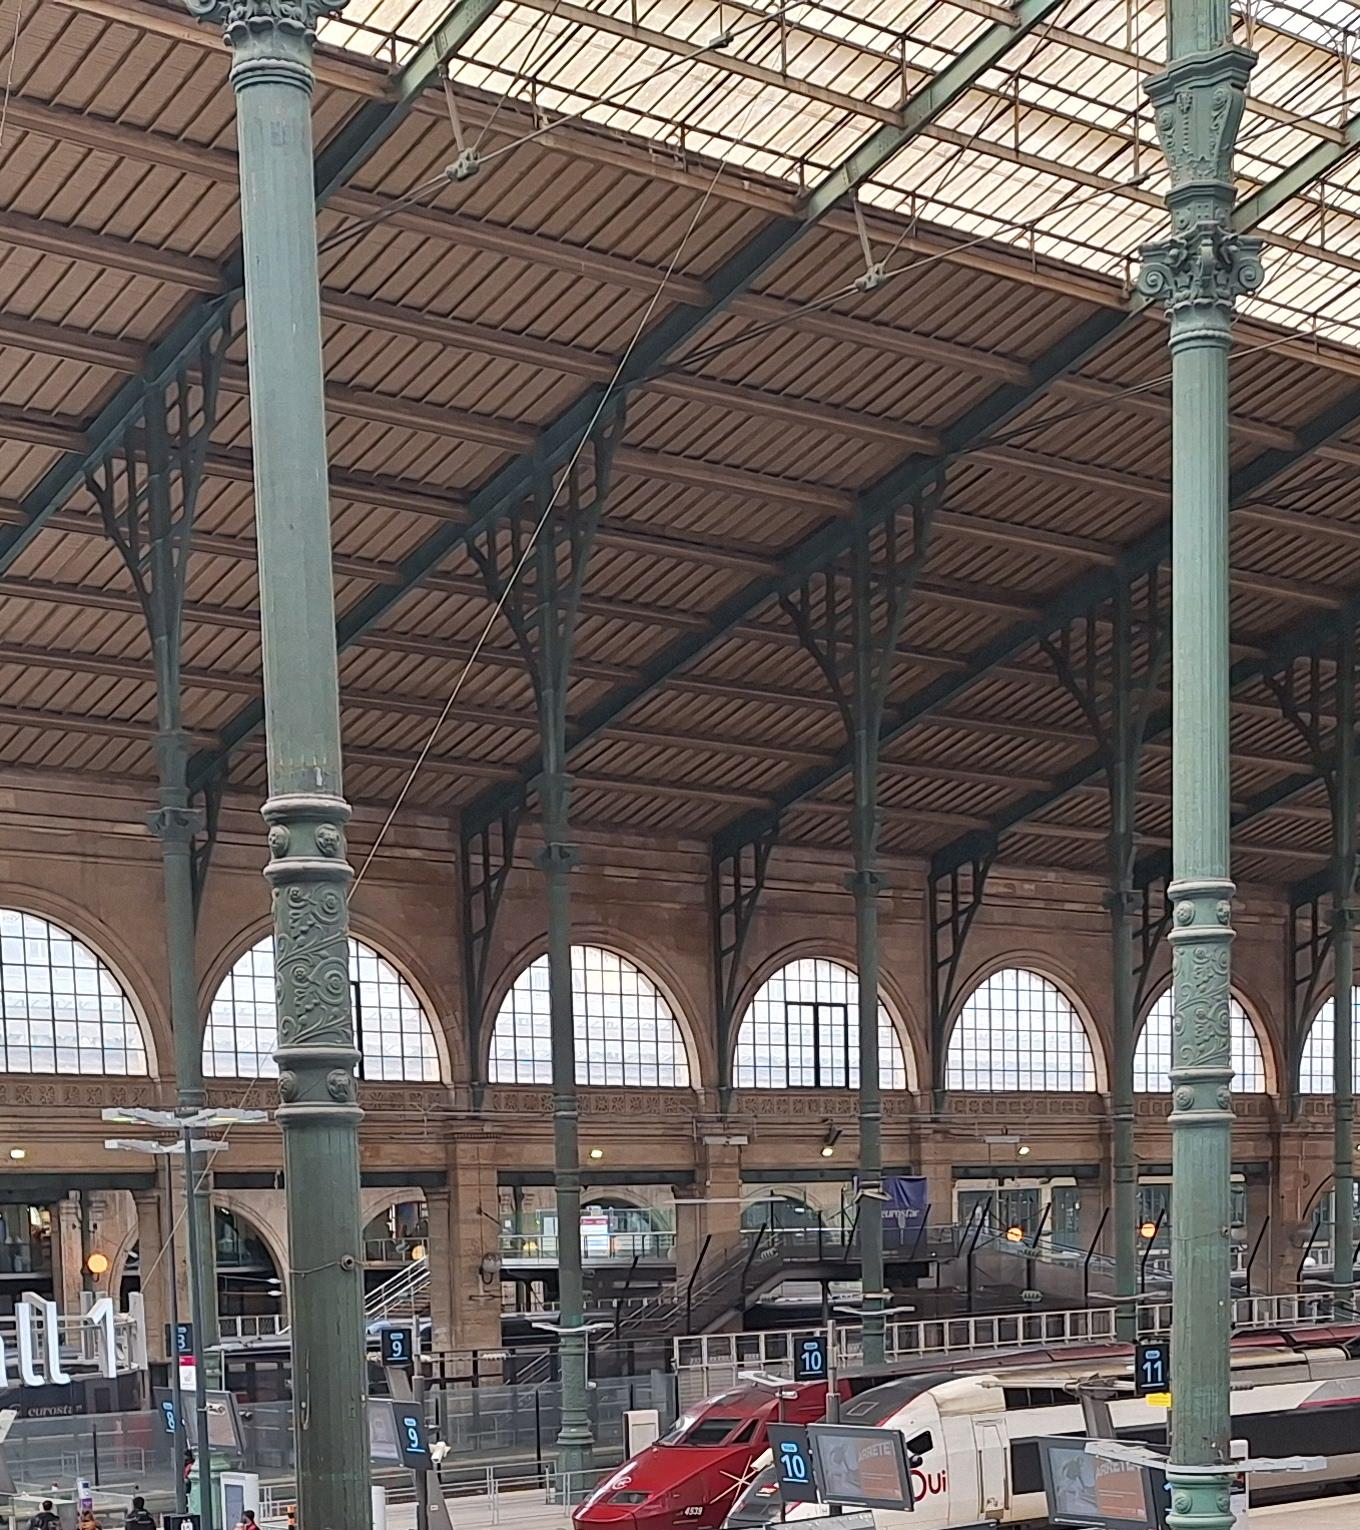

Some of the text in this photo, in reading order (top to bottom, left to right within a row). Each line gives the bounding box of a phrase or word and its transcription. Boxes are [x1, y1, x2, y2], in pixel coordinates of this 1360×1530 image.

[85, 1297, 118, 1379] 1
[392, 1340, 403, 1357] 9
[800, 1351, 822, 1371] 10
[1142, 1360, 1163, 1383] 11
[407, 1427, 419, 1449] 9
[780, 1454, 806, 1478] 10
